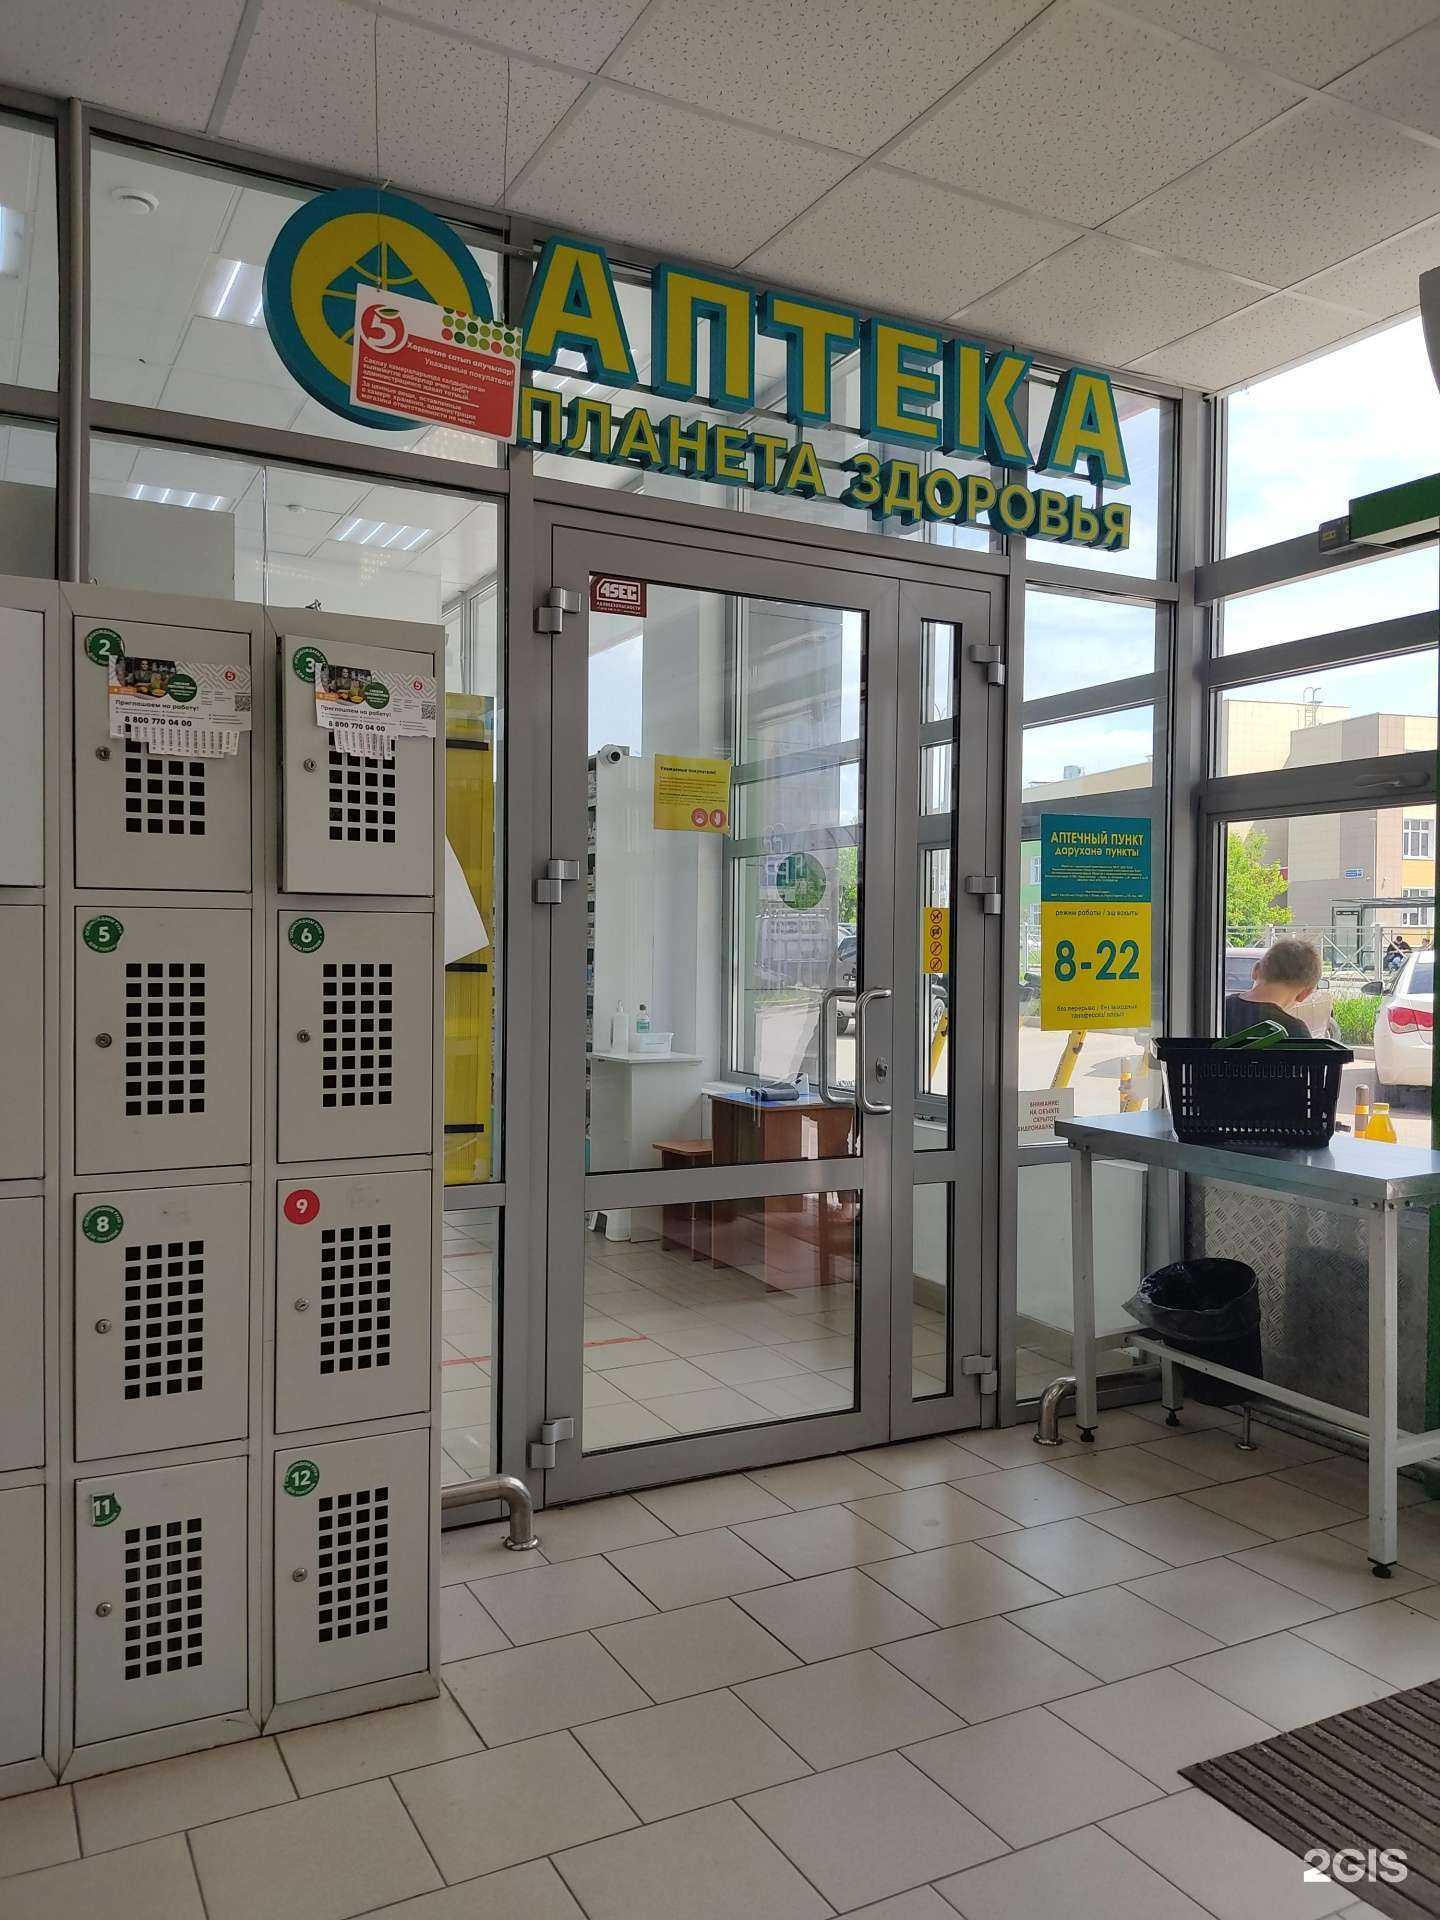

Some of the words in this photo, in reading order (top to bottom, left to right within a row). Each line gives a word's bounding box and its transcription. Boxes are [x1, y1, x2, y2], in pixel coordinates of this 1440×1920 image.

[523, 236, 1130, 488] АПТЕКА
[520, 387, 825, 498] ПЛАНЕТА
[841, 453, 1130, 552] ЗДОРОВЬЯ
[600, 582, 638, 601] 4SEC
[98, 639, 111, 656] 2
[305, 657, 315, 673] 3
[115, 699, 161, 709] Приглашаем
[172, 704, 200, 713] работу!
[320, 704, 359, 714] Приглашаем
[368, 710, 392, 719] работу!
[125, 715, 130, 723] 8
[132, 716, 149, 725] 800
[152, 717, 165, 725] 770
[168, 718, 179, 726] 04
[181, 719, 192, 727] 00
[328, 719, 333, 727] 8
[334, 720, 349, 729] 800
[351, 722, 363, 730] 770
[376, 724, 386, 732] 00
[1051, 830, 1108, 846] АПТЕЧНЫЙ
[1111, 833, 1144, 847] ПУНКТ
[1105, 848, 1139, 859] пункты
[98, 926, 111, 943] 5
[301, 927, 312, 943] 6
[1054, 939, 1140, 982] 8-22
[296, 1198, 308, 1214] 9
[97, 1216, 109, 1233] 8
[292, 1470, 311, 1487] 12
[93, 1498, 111, 1516] 11
